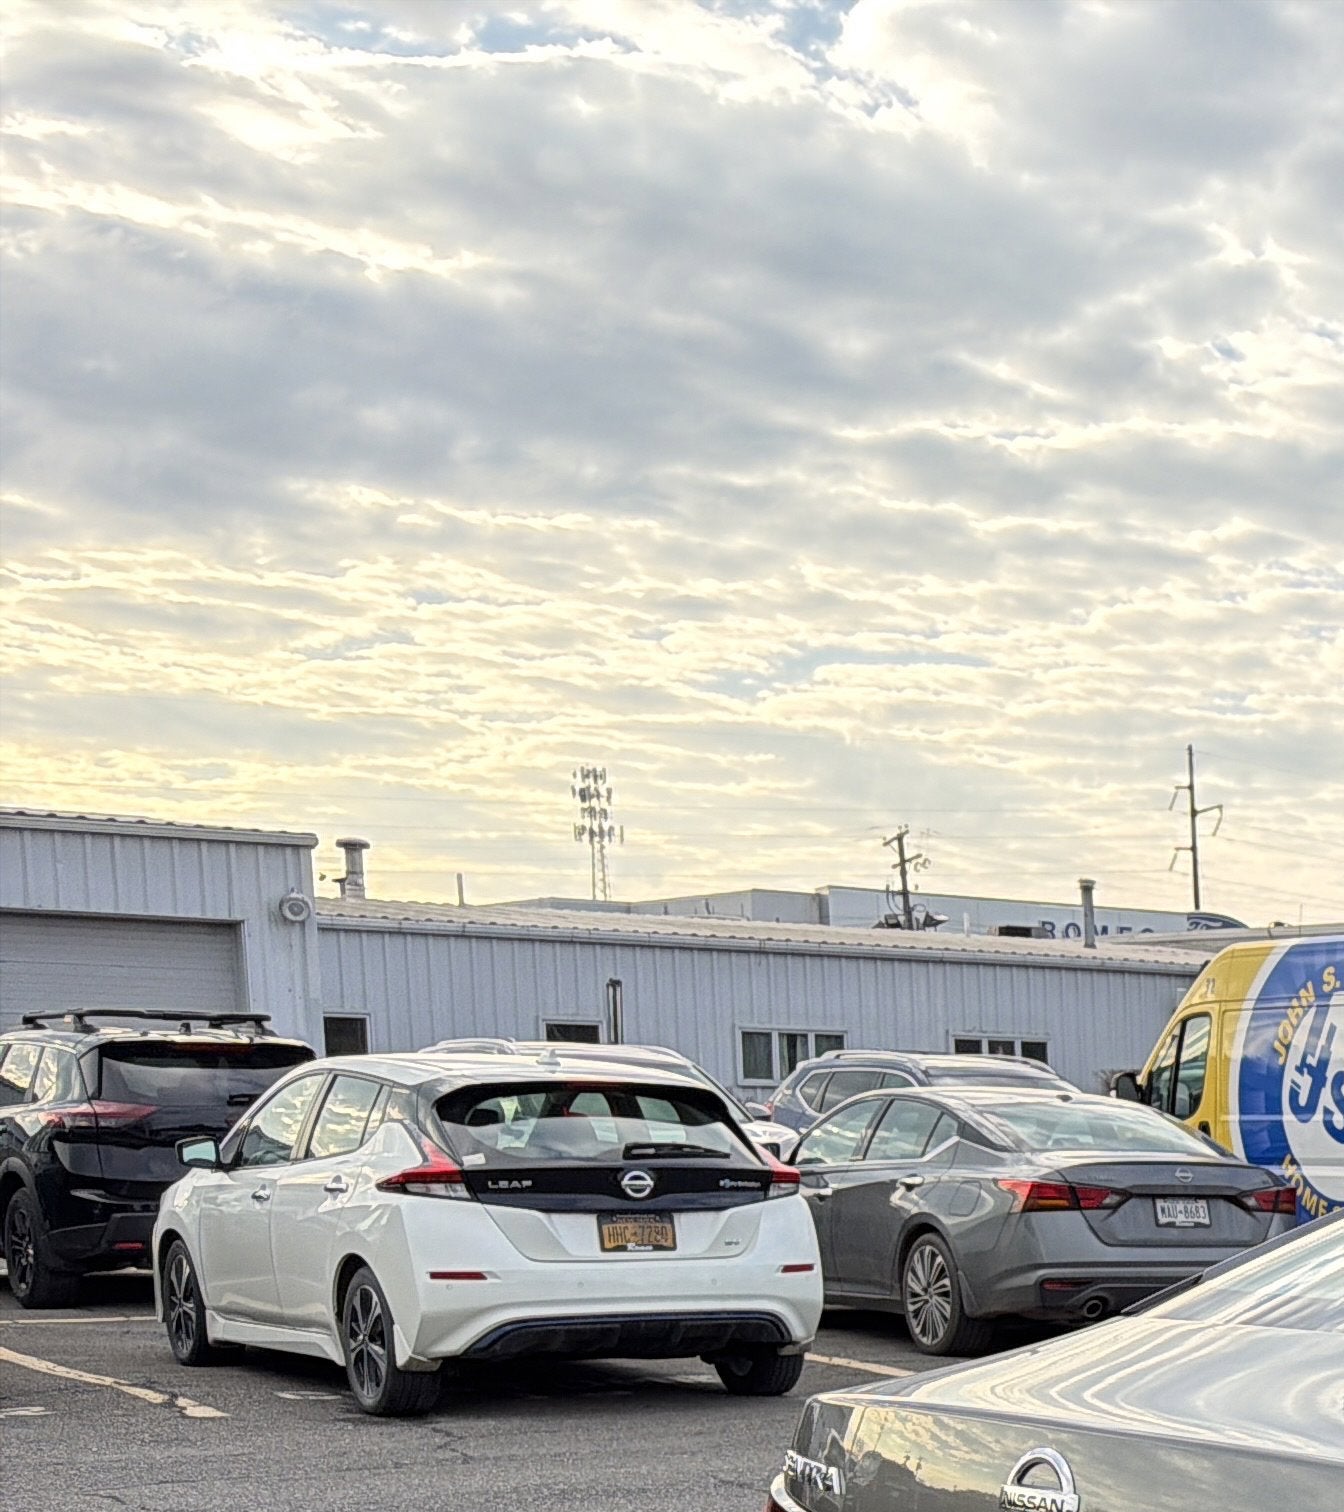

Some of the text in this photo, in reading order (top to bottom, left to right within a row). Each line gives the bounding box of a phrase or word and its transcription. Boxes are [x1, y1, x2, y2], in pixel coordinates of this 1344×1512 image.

[1272, 981, 1317, 1067] JOHN
[1322, 965, 1341, 993] S.
[488, 1179, 533, 1189] LEAF
